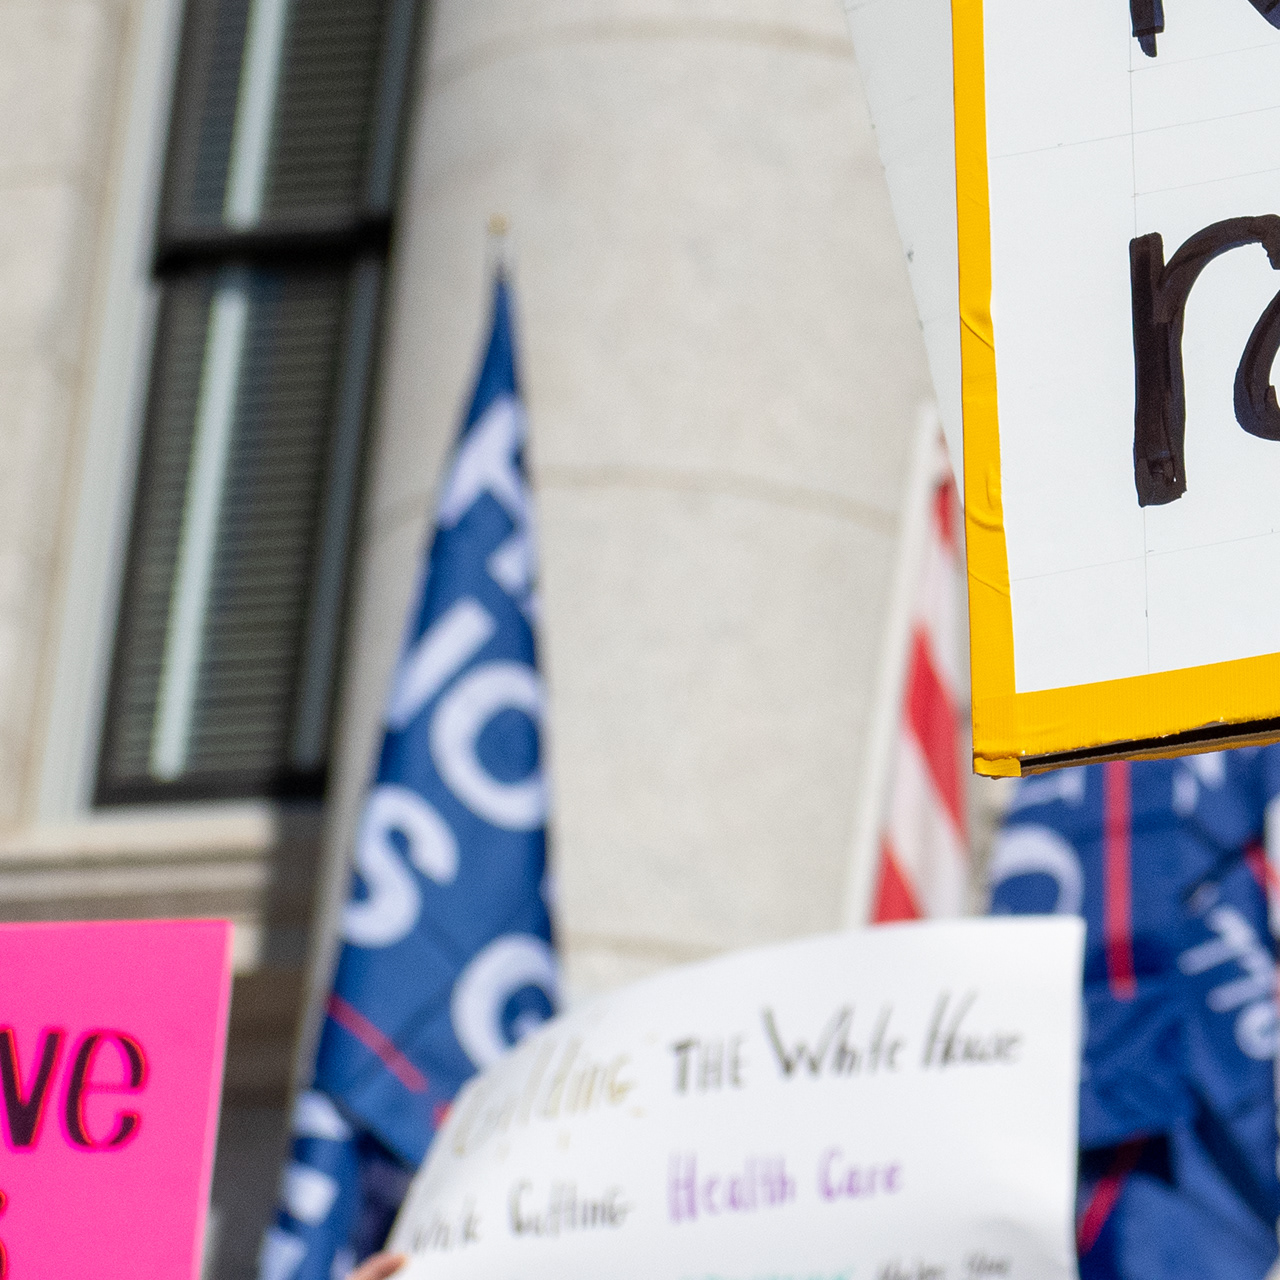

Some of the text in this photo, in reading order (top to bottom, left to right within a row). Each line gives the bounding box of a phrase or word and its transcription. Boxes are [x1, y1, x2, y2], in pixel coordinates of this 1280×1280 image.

[0, 1027, 148, 1149] ve
[666, 1150, 798, 1225] Health
[817, 1145, 904, 1204] Care
